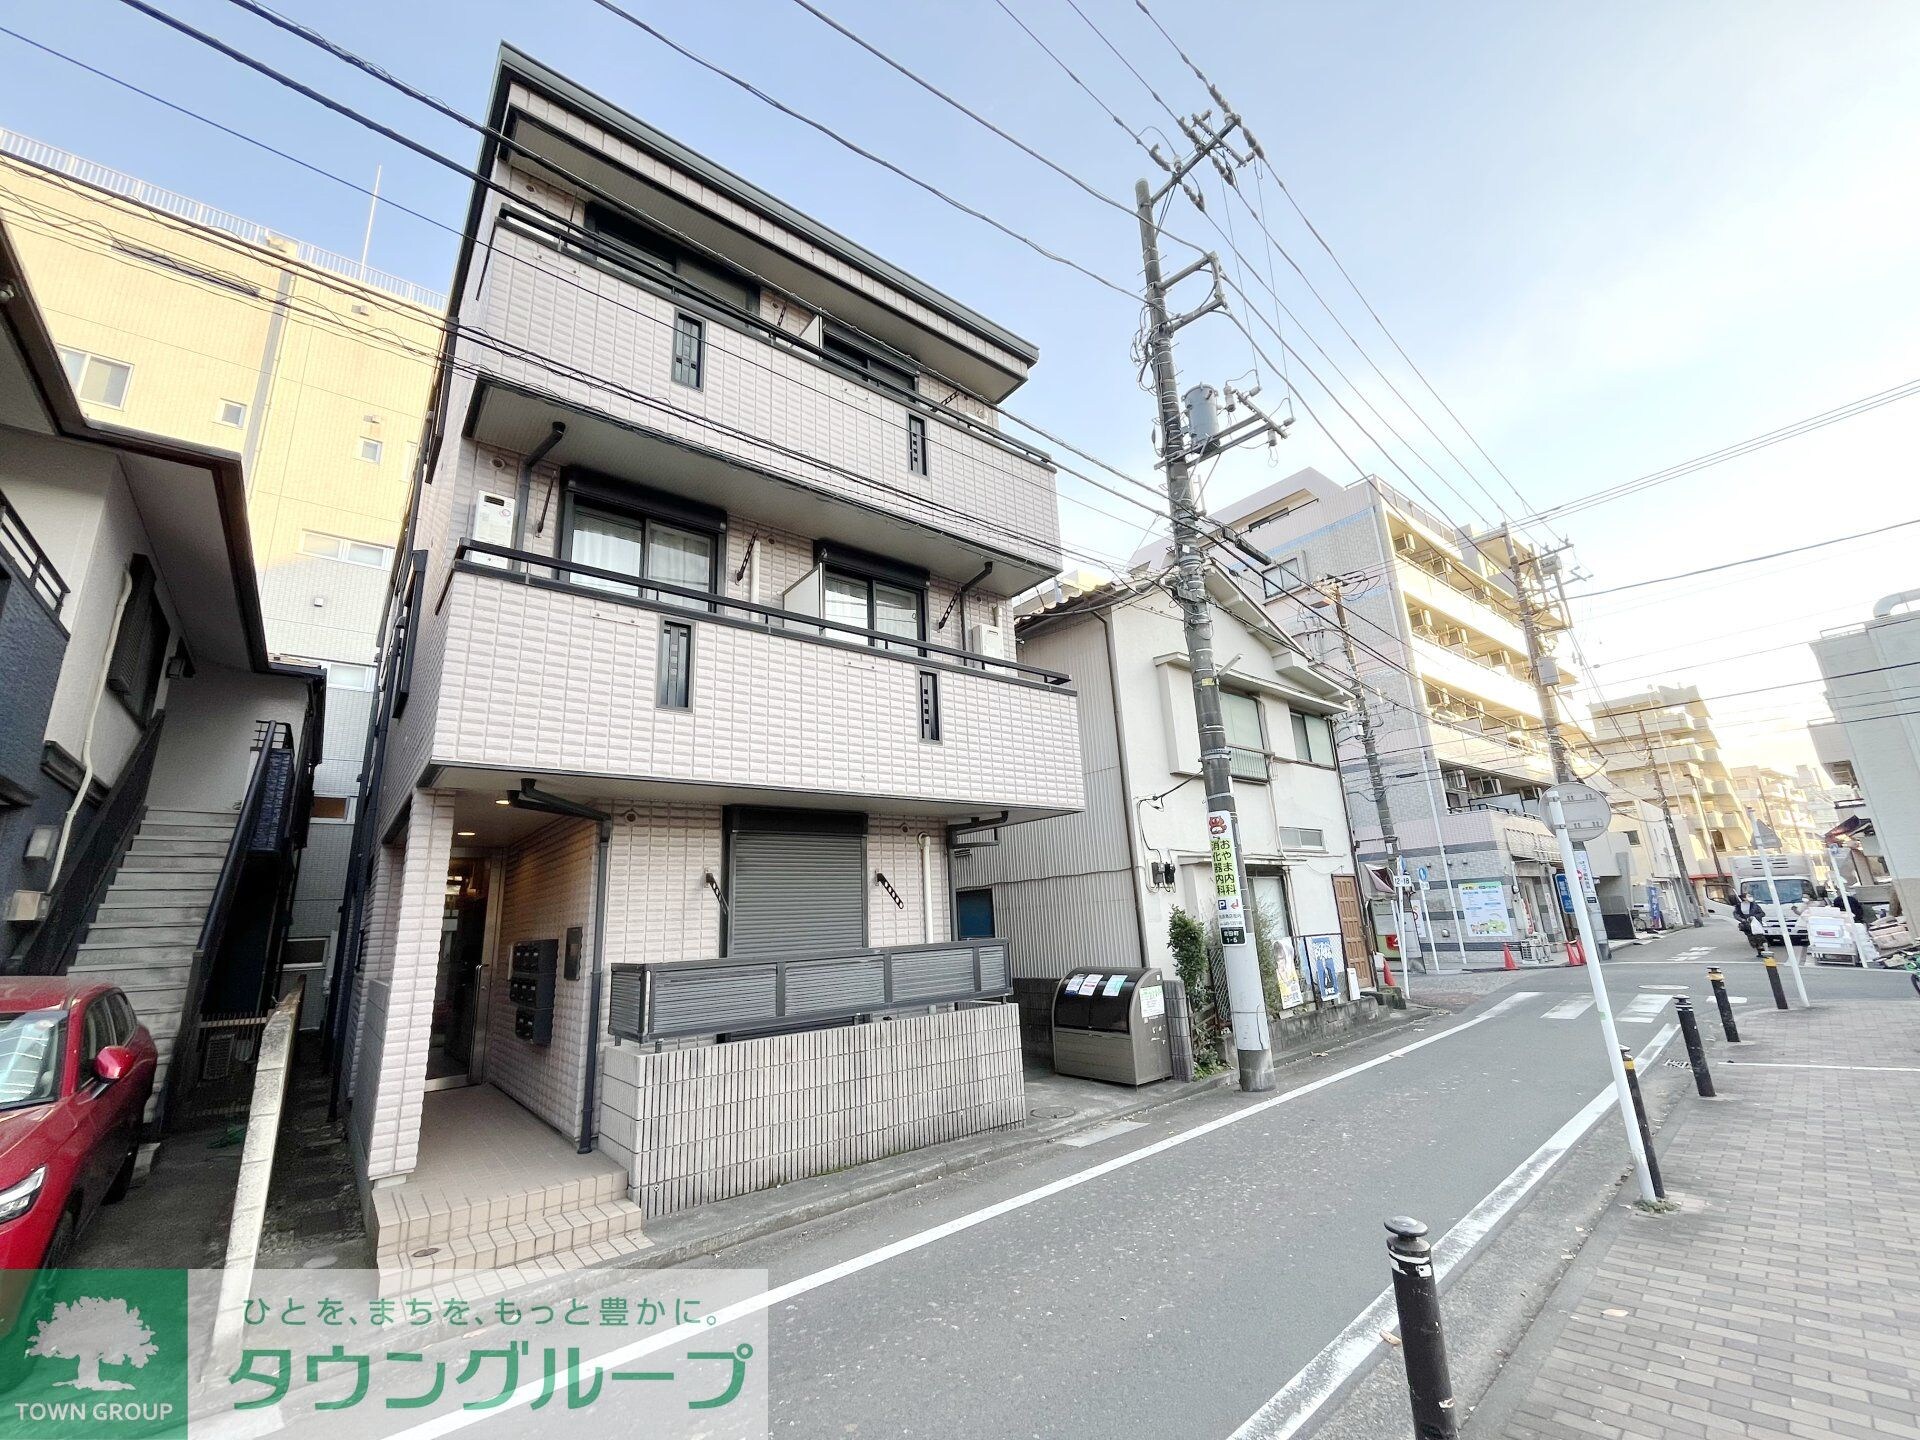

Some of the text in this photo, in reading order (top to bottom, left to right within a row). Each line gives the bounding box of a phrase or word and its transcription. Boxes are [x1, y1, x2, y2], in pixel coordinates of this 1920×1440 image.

[1211, 839, 1226, 896] 消化器内科
[1220, 839, 1236, 895] おやま内科
